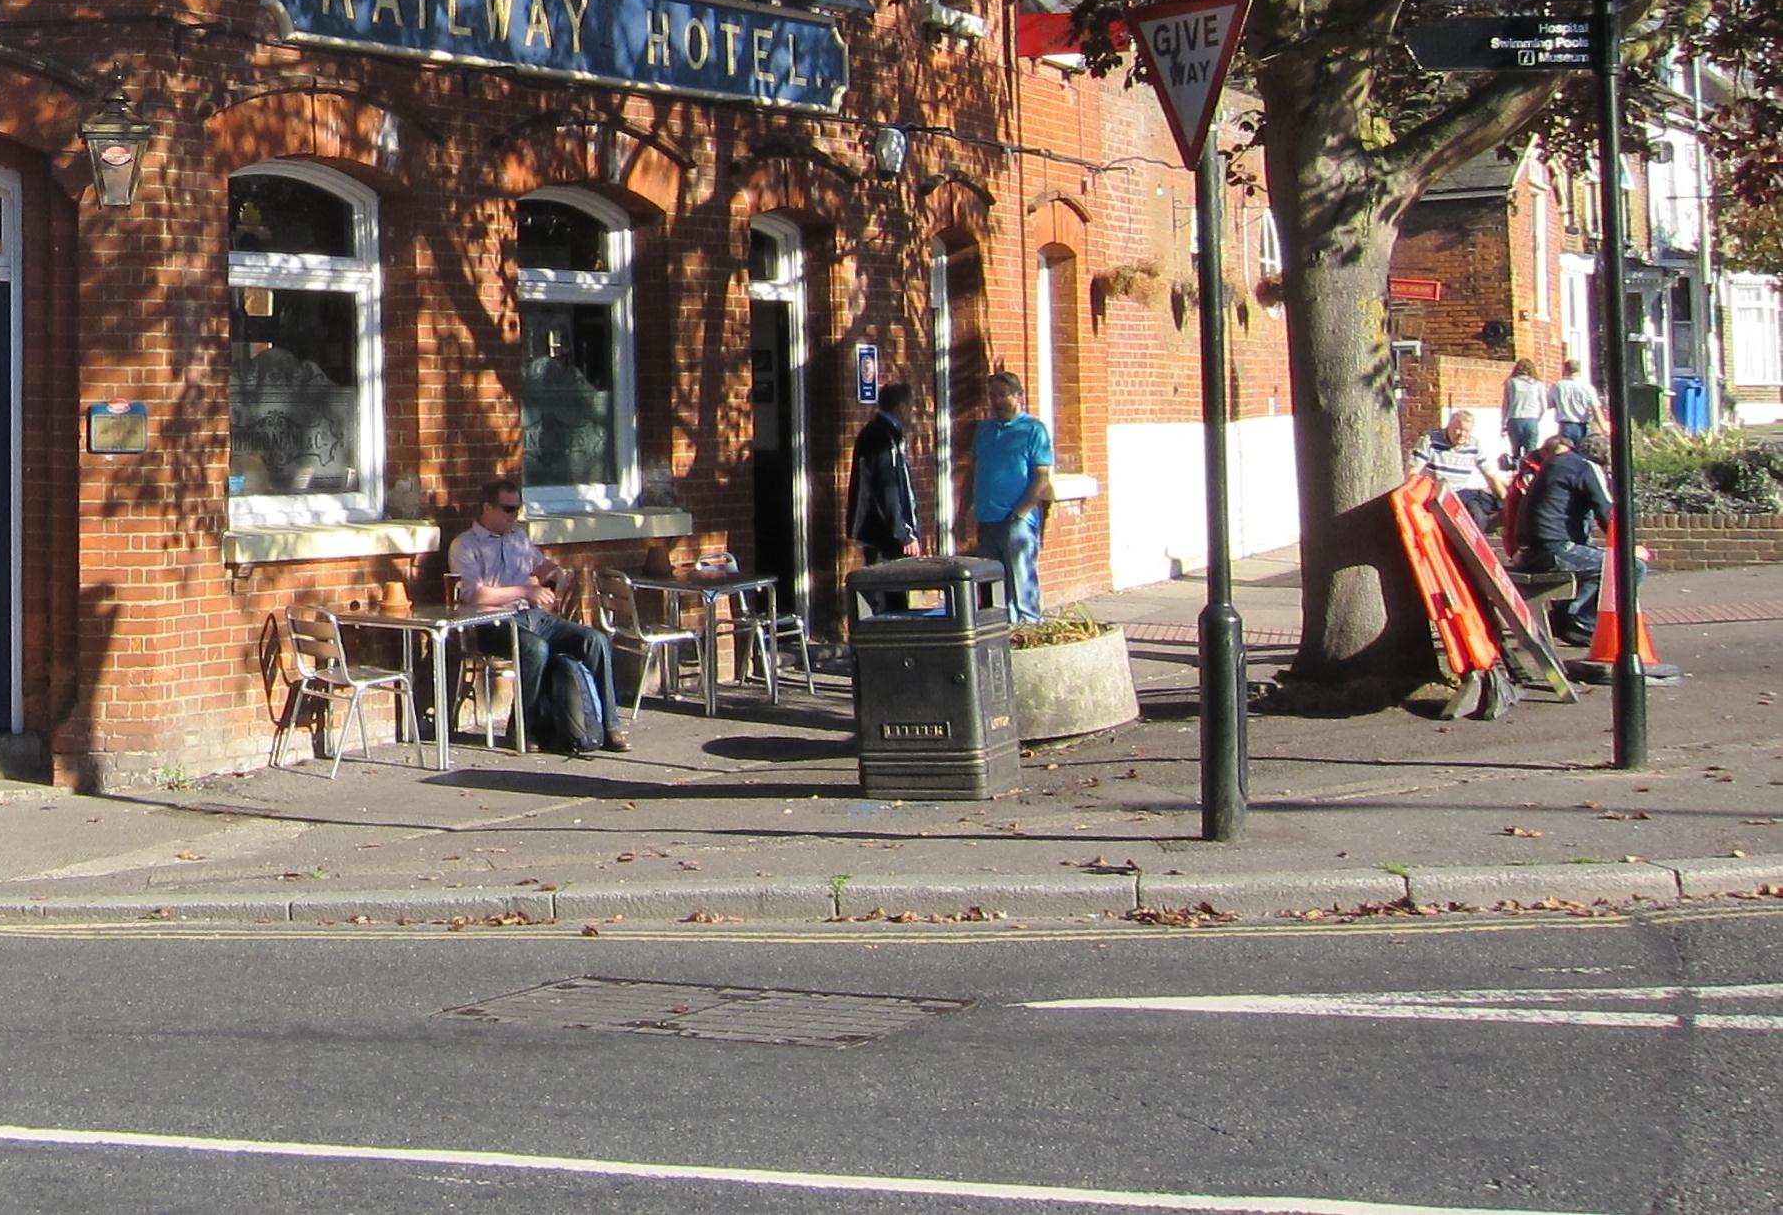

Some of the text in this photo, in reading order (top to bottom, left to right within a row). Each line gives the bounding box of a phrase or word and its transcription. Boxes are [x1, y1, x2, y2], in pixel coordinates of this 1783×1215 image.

[1153, 14, 1219, 57] GIVE
[1538, 23, 1589, 36] Hospital
[1490, 37, 1589, 51] Swimming Pools
[1538, 52, 1589, 63] Museum
[1168, 58, 1211, 86] WAY
